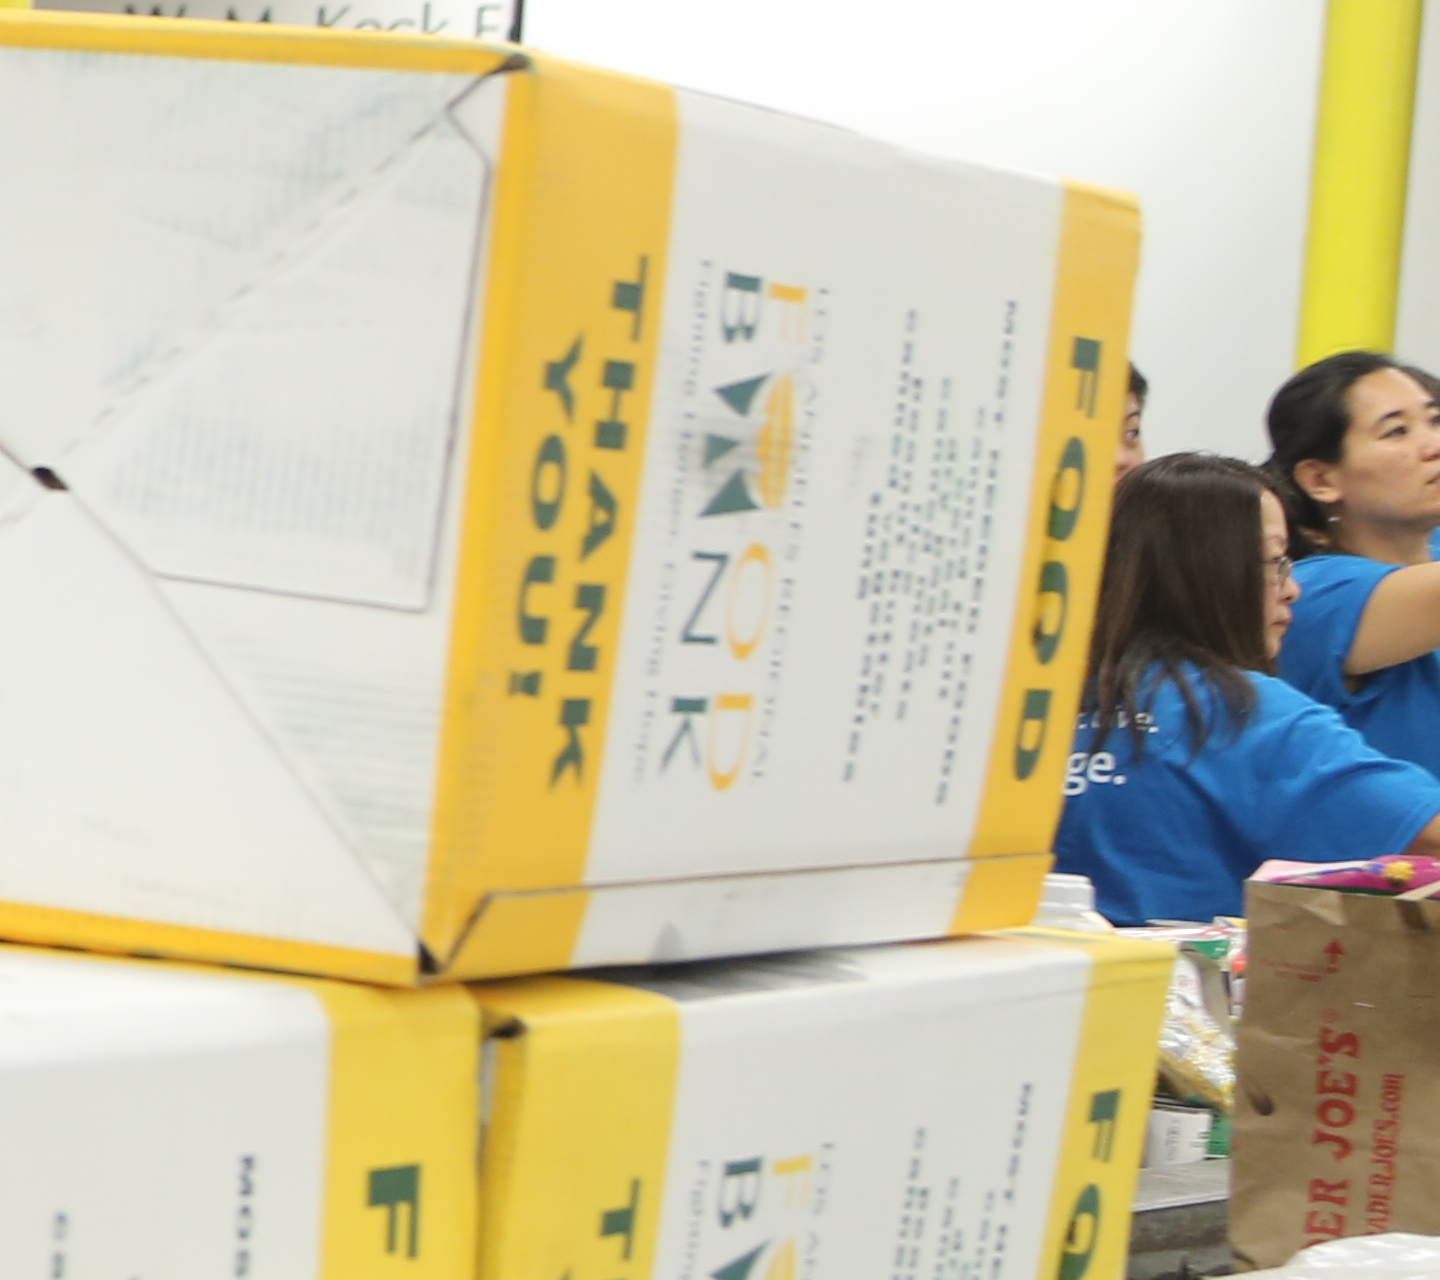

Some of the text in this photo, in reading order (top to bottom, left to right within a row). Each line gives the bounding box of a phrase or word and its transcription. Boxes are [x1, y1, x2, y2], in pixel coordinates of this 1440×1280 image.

[508, 331, 586, 698] YOU!
[548, 255, 650, 793] THANK
[1015, 336, 1103, 782] FOOD
[1310, 1026, 1361, 1161] JOE'S
[1364, 1071, 1406, 1236] ADERJOES.com
